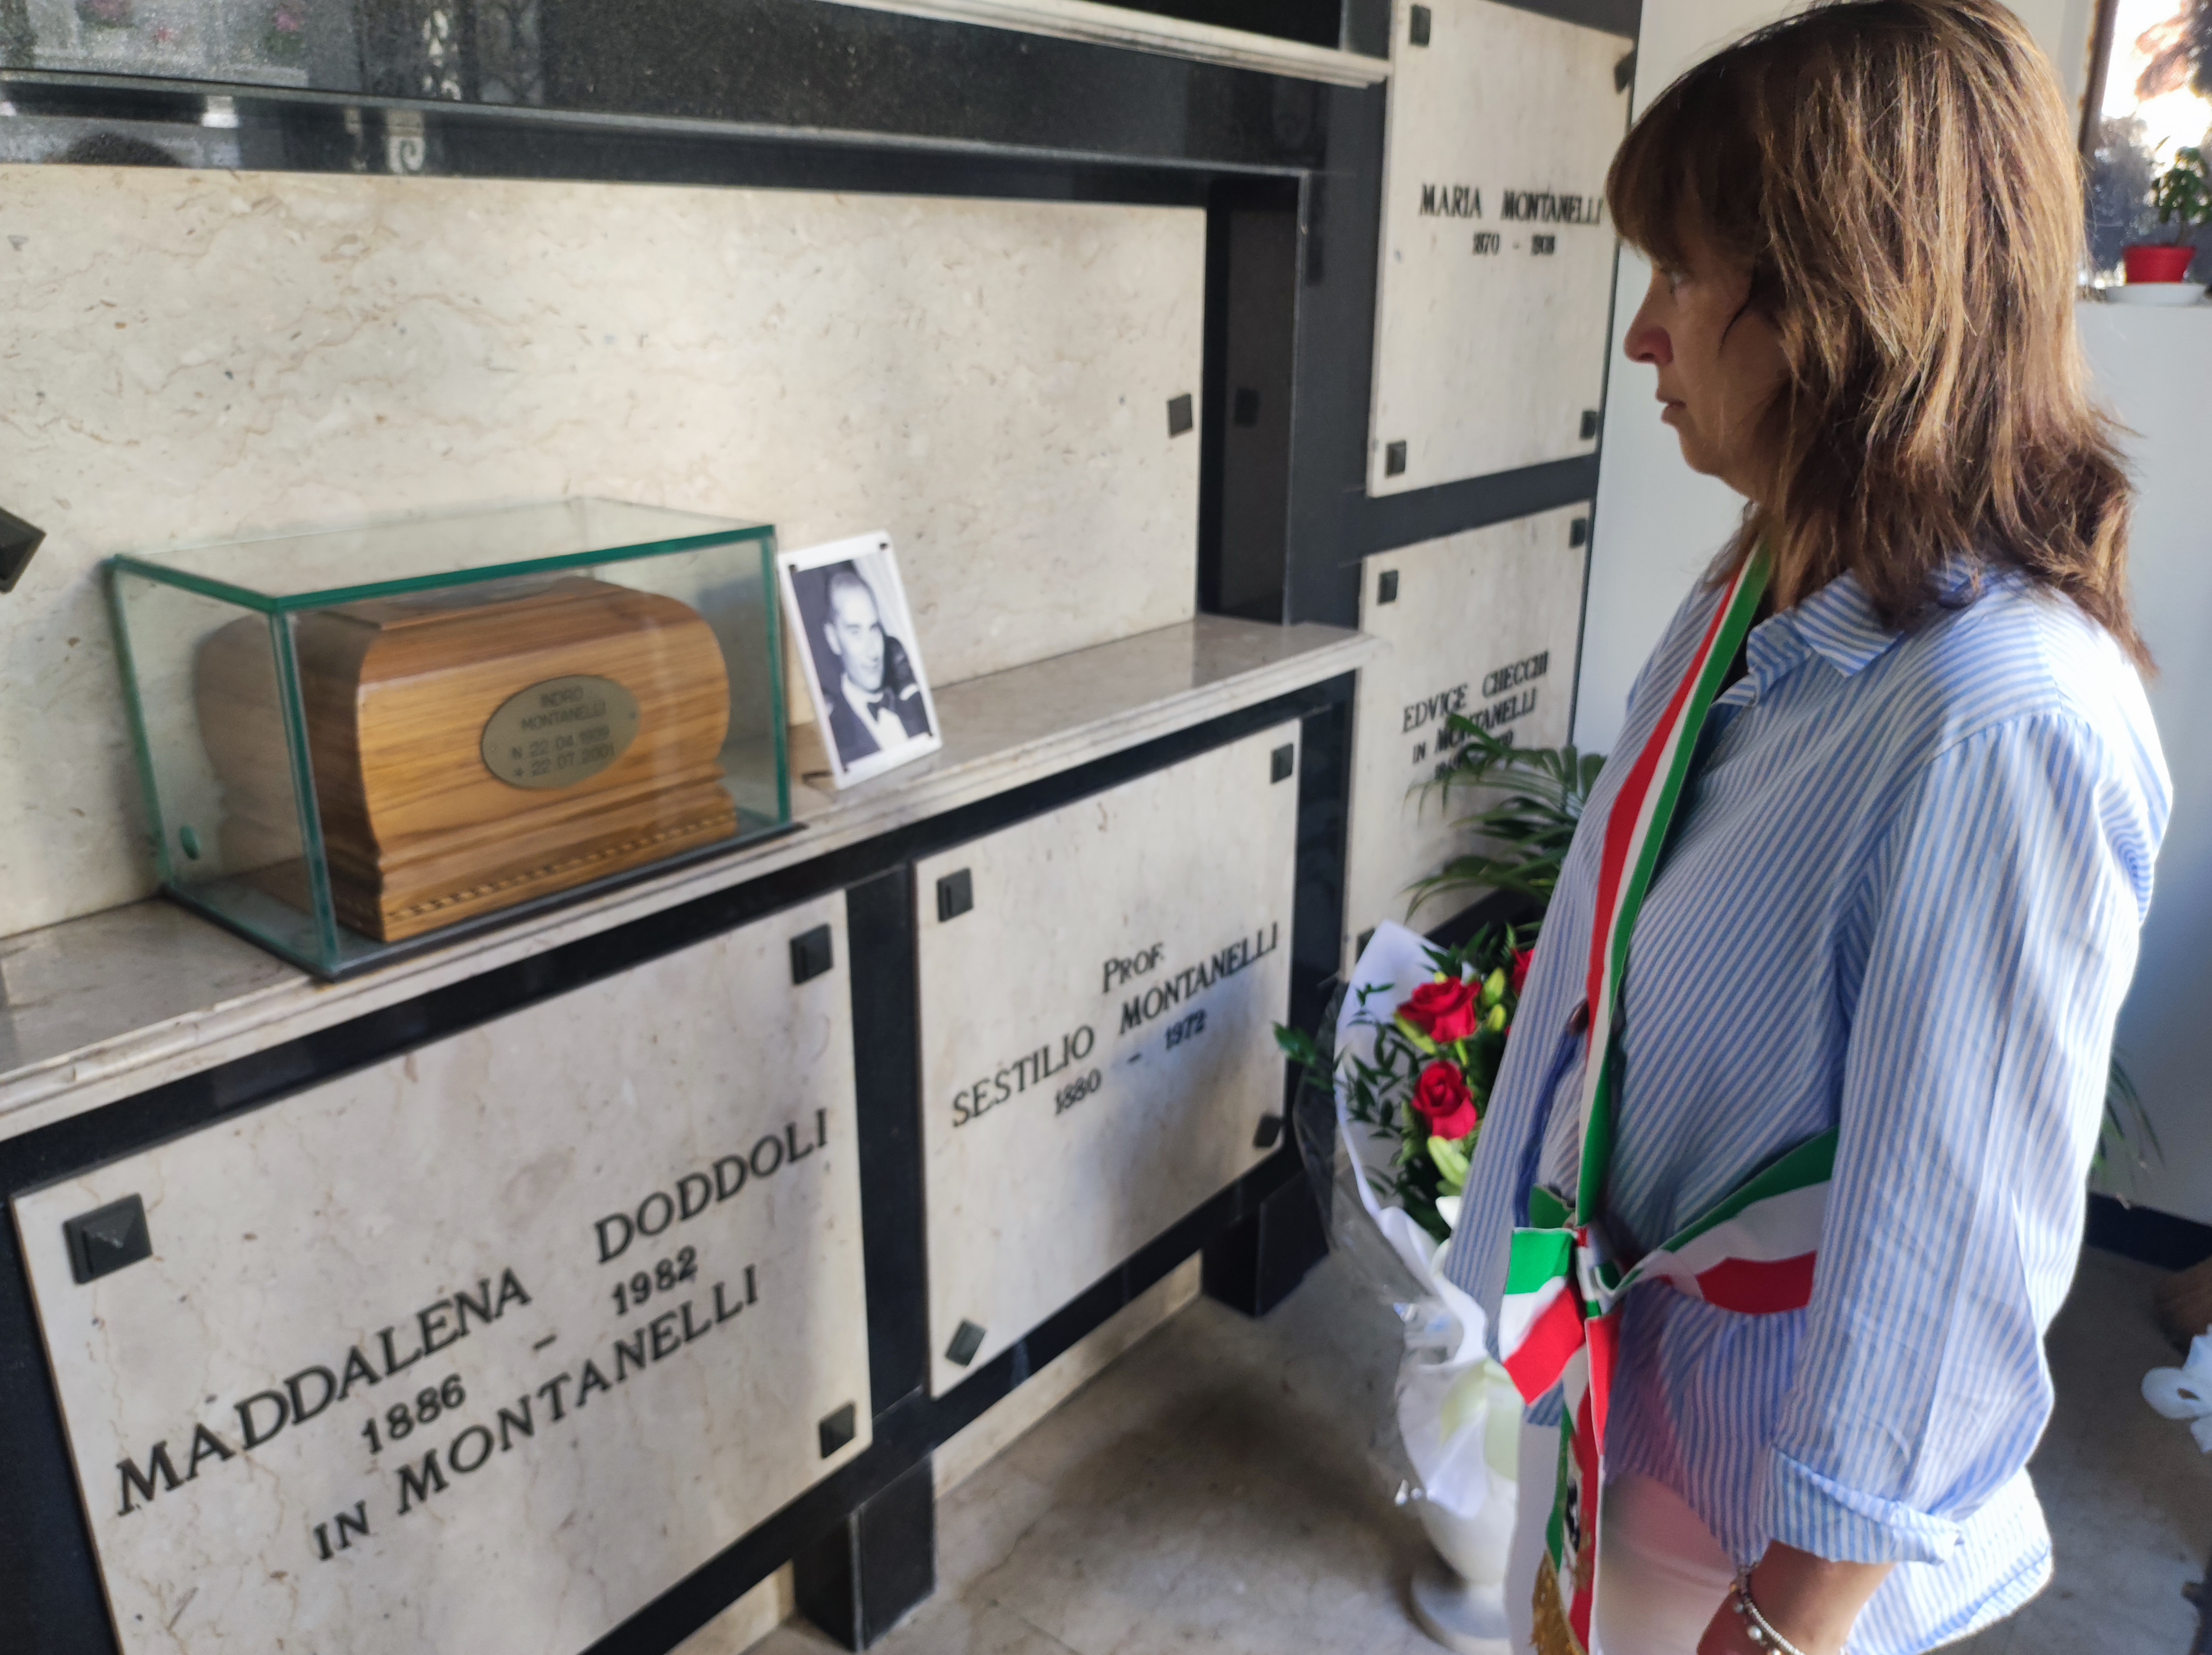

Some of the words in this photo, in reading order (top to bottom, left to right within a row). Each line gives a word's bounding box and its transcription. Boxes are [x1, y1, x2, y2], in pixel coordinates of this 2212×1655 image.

[1419, 184, 1482, 219] MARIA
[1501, 189, 1603, 225] MONTANELLI
[521, 699, 607, 731] MONTANELLI
[1483, 649, 1548, 698] CHECCHI
[1412, 741, 1426, 764] IN
[952, 1025, 1094, 1127] SESTILIO
[1120, 921, 1278, 1035] MONTANELLI
[1054, 1068, 1102, 1115] 1880
[1165, 1009, 1205, 1050] 1972
[116, 1267, 532, 1517] MADDALENA
[594, 1108, 828, 1265] DODDOLI
[360, 1373, 467, 1455] 1886
[611, 1245, 698, 1315] 1982
[312, 1500, 371, 1560] IN
[395, 1263, 758, 1515] MONTANELLI
